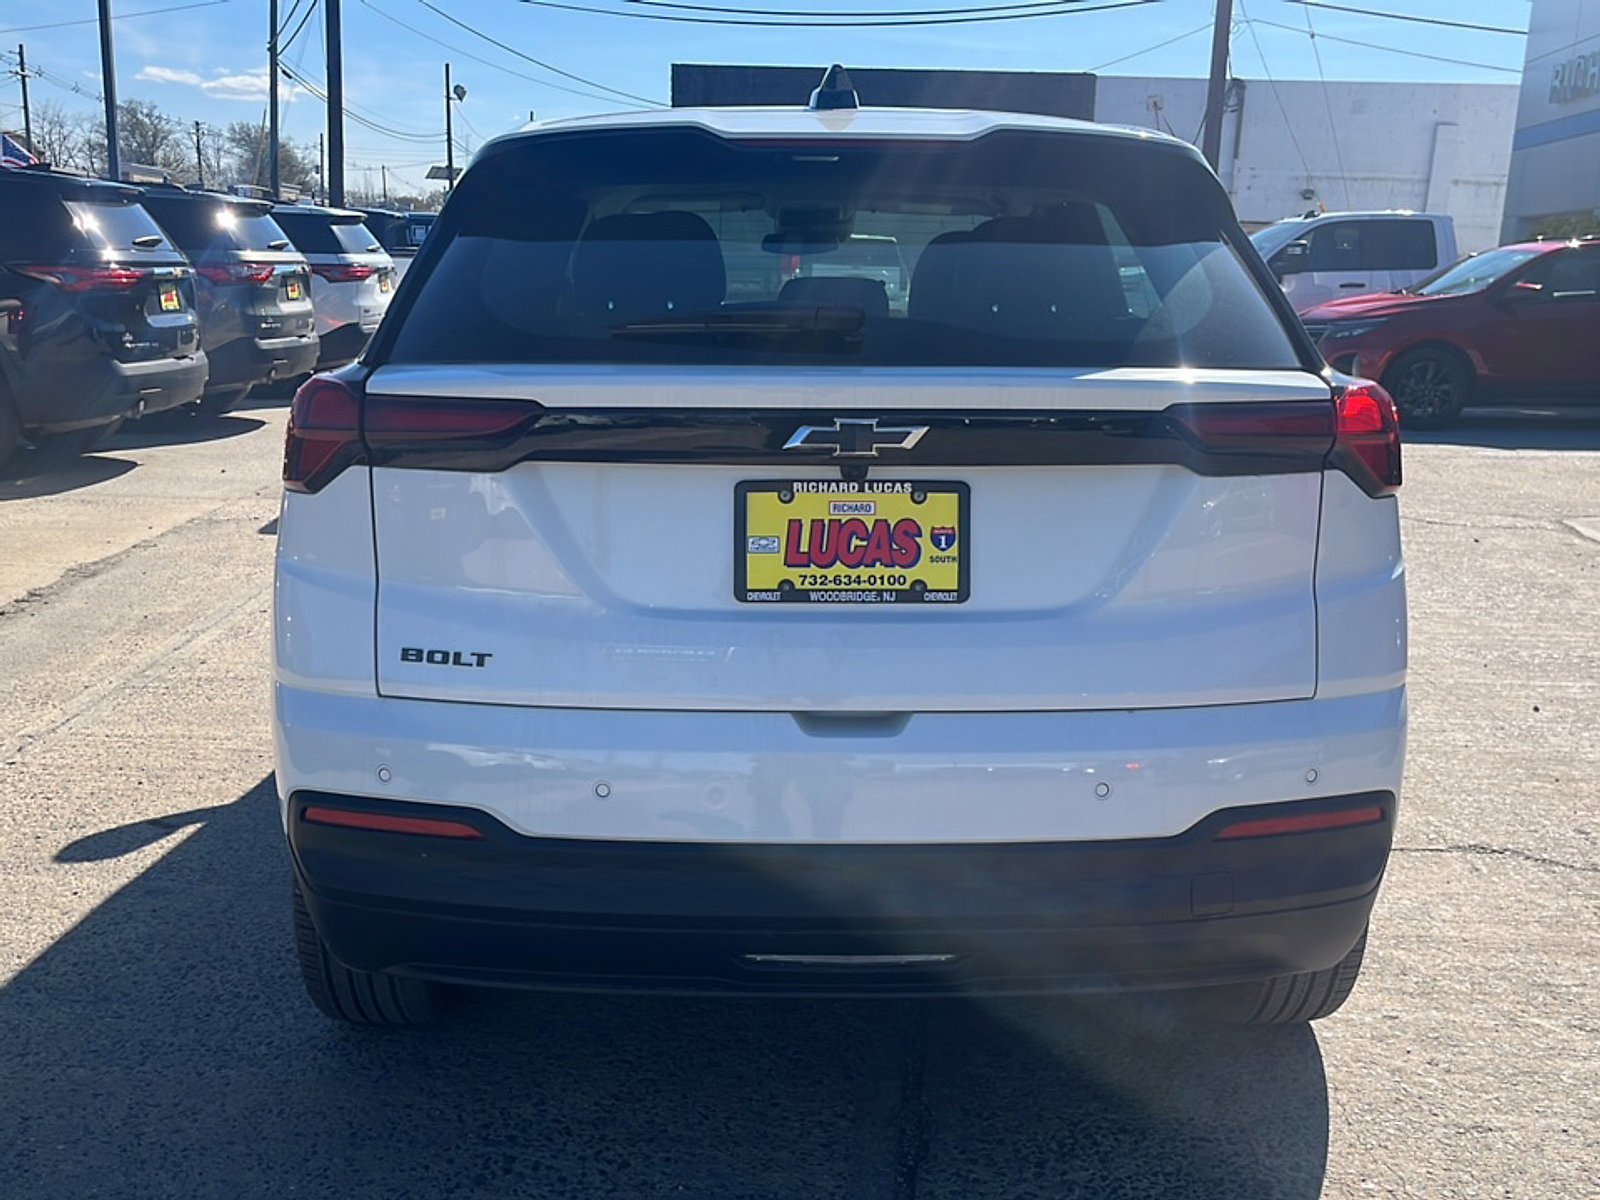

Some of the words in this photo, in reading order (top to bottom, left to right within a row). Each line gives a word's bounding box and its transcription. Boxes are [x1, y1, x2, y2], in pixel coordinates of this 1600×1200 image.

[793, 482, 859, 493] RICHARD
[864, 482, 912, 493] LUCAS
[833, 503, 872, 514] RICHARD
[783, 517, 923, 569] LUCAS
[939, 534, 948, 550] 1
[930, 555, 958, 563] SOUTH
[798, 574, 907, 587] 732-634-0100
[883, 590, 897, 602] NJ
[400, 646, 492, 668] BOLT
